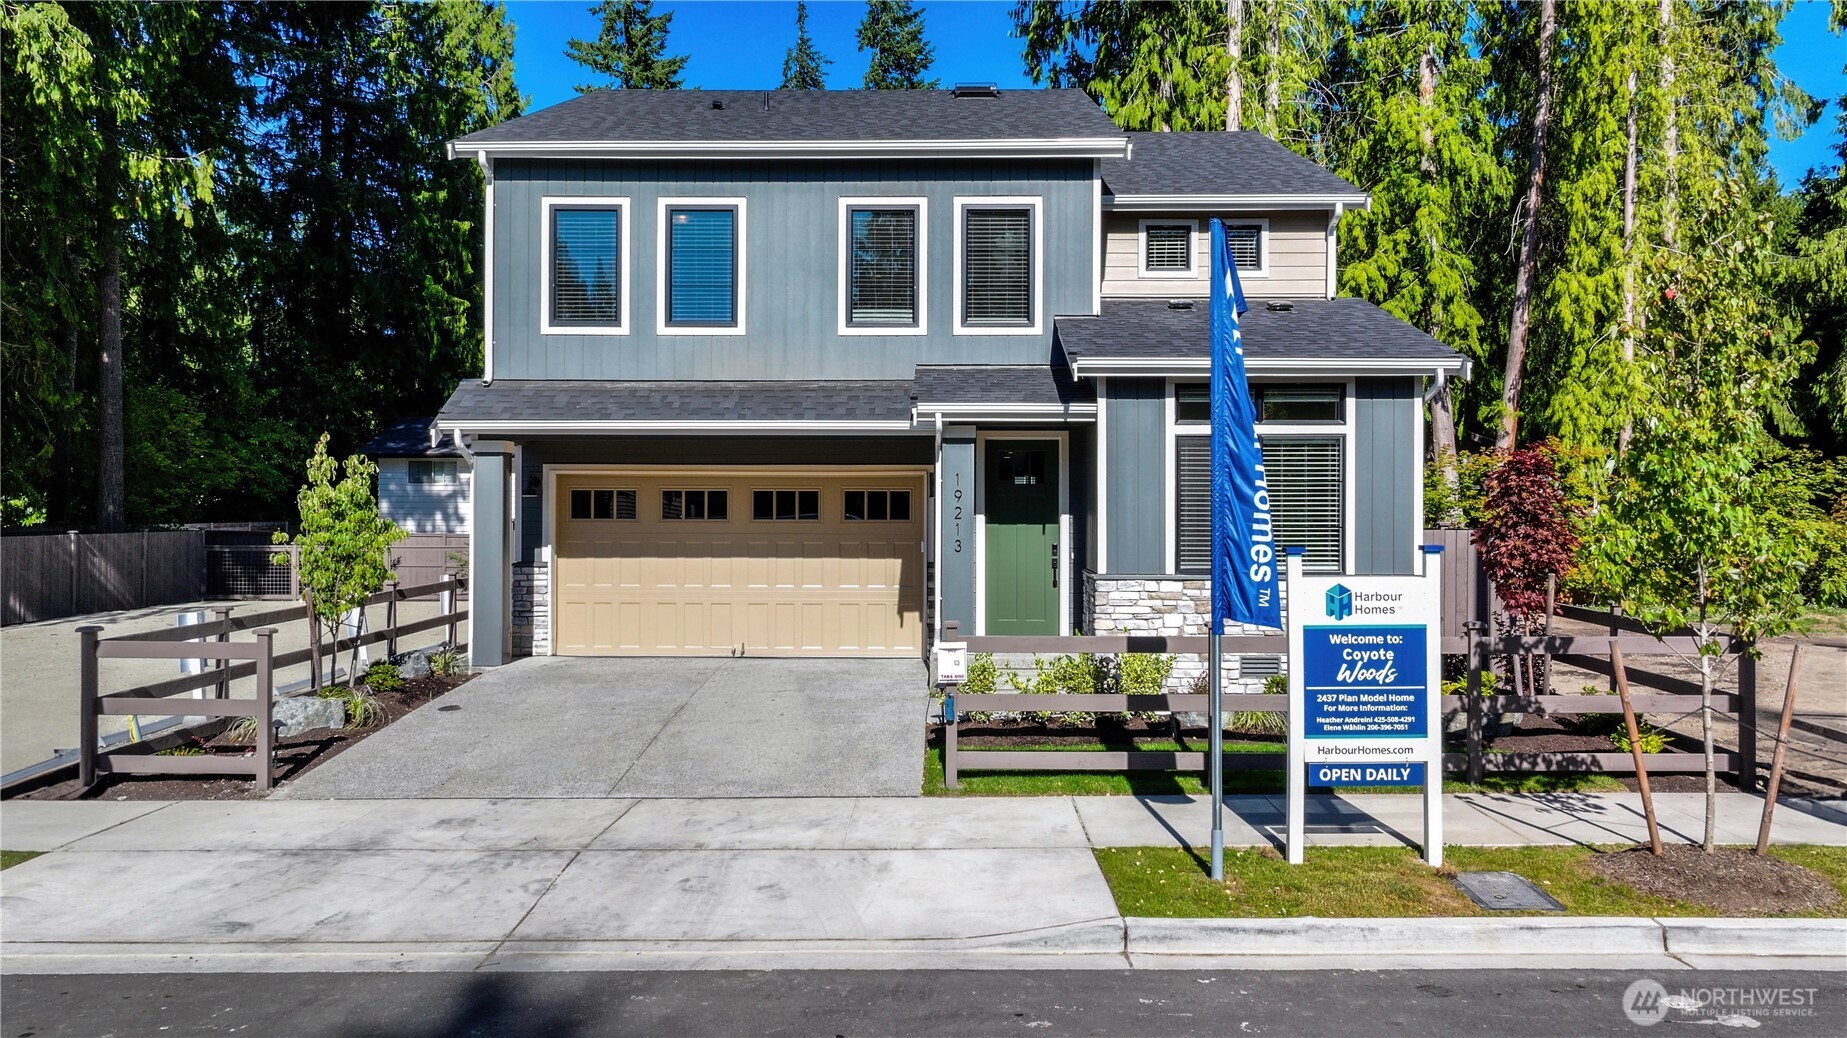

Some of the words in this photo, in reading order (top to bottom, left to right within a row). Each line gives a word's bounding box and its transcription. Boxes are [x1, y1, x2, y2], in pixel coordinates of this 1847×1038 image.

[953, 472, 964, 553] 19213
[1354, 591, 1403, 602] Harbour
[1354, 604, 1396, 615] Homes
[1329, 634, 1384, 645] Welcome
[1386, 634, 1403, 644] to:
[1342, 648, 1395, 663] Coyote
[1336, 660, 1399, 685] Woods
[1316, 694, 1337, 703] 2437
[1338, 693, 1358, 702] Plan
[1360, 693, 1387, 702] Model
[1388, 693, 1415, 702] Home
[1323, 704, 1337, 712] For
[1338, 704, 1358, 712] More
[1360, 703, 1408, 711] Information:
[1316, 716, 1344, 724] Heather
[1373, 715, 1415, 723] 425-508-4291
[1367, 723, 1408, 731] 206-396-7051
[1317, 745, 1414, 755] HarbourHomes.com
[1319, 768, 1361, 781] OPEN
[1366, 768, 1411, 781] DAILY
